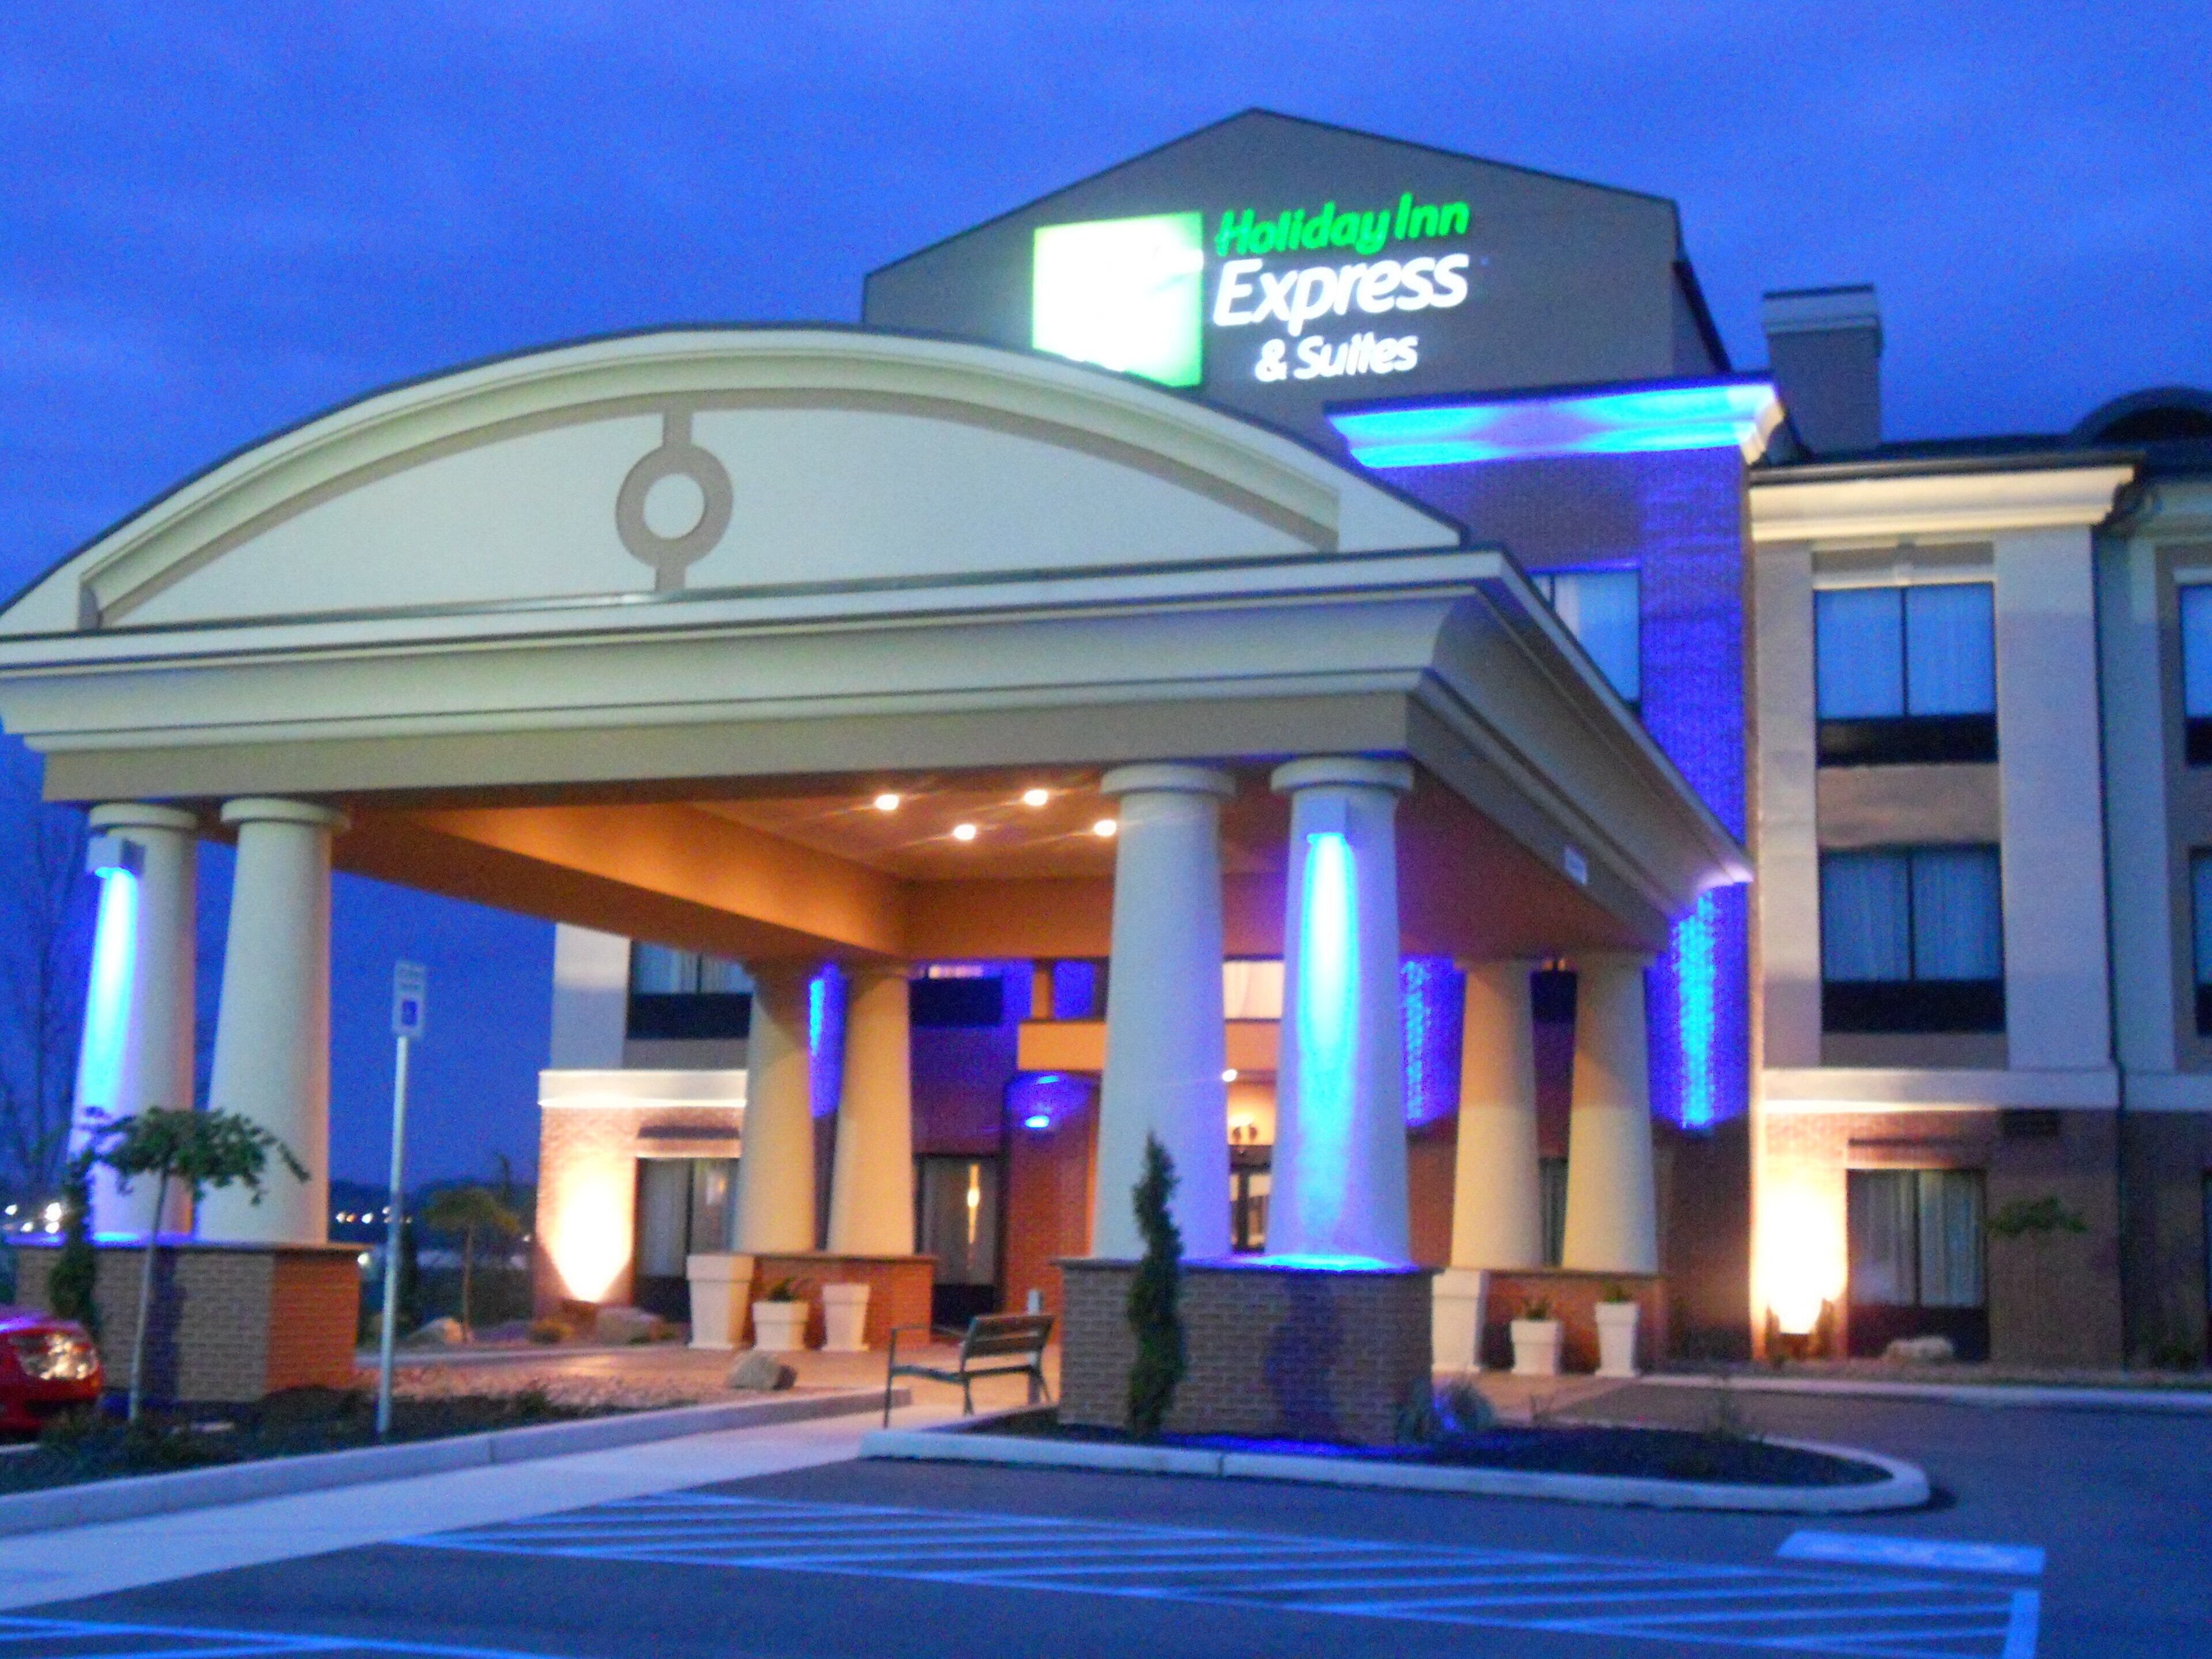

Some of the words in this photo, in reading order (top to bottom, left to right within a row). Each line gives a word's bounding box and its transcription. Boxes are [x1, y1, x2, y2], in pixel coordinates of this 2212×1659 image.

[1217, 202, 1389, 254] Holiday
[1395, 193, 1469, 240] Inn
[1214, 255, 1469, 335] Express
[1256, 339, 1287, 381] &
[1294, 333, 1418, 379] Suites
